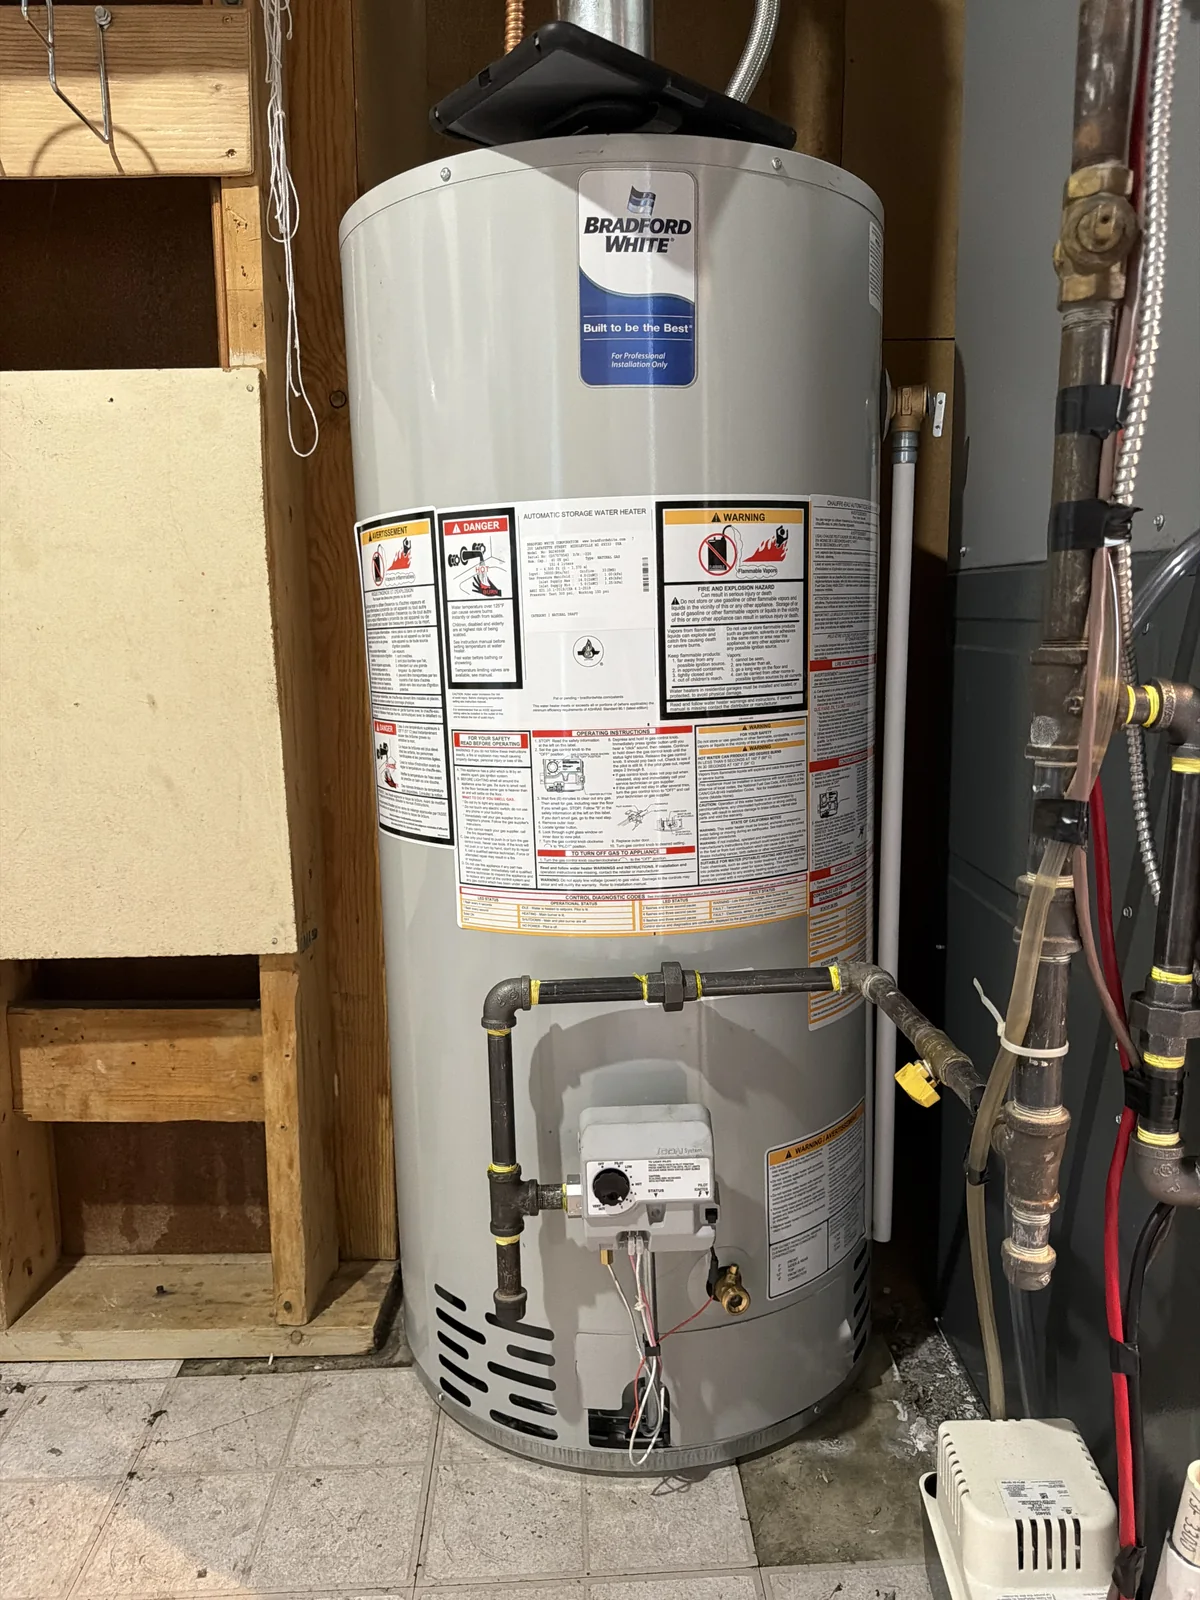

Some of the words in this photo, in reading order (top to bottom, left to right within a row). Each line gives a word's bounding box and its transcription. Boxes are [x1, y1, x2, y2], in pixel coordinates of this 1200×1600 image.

[584, 217, 692, 234] BRADFORD
[583, 323, 607, 333] Built
[610, 324, 621, 332] to
[625, 323, 639, 332] be
[643, 323, 660, 332] the
[651, 361, 668, 370] Only
[723, 513, 766, 521] WARNING
[464, 521, 499, 531] DANGER
[372, 526, 407, 539] AVERTISSEMENT
[795, 1138, 822, 1154] WARNING
